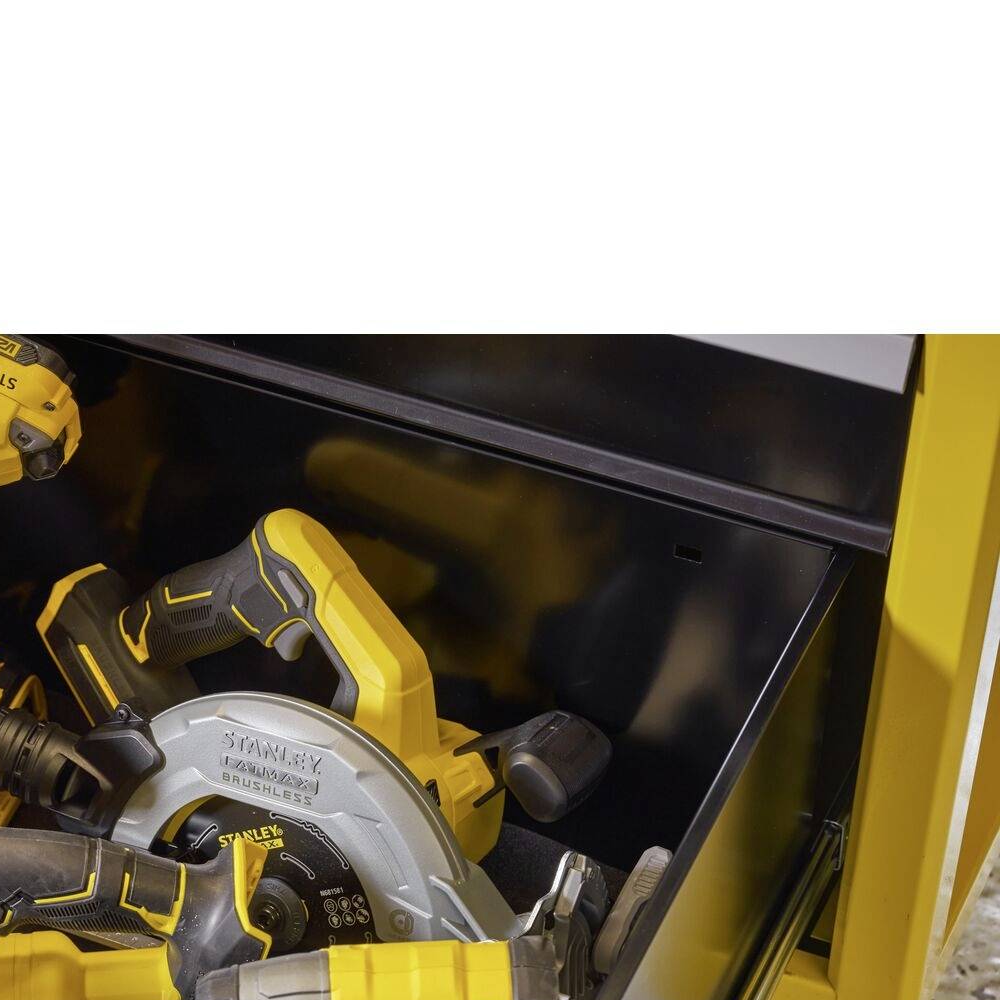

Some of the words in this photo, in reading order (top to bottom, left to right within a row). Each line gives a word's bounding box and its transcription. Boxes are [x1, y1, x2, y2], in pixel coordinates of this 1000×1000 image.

[222, 730, 322, 774] STANLEY
[222, 772, 313, 807] BRUSHLESS
[225, 754, 309, 791] FATMAX
